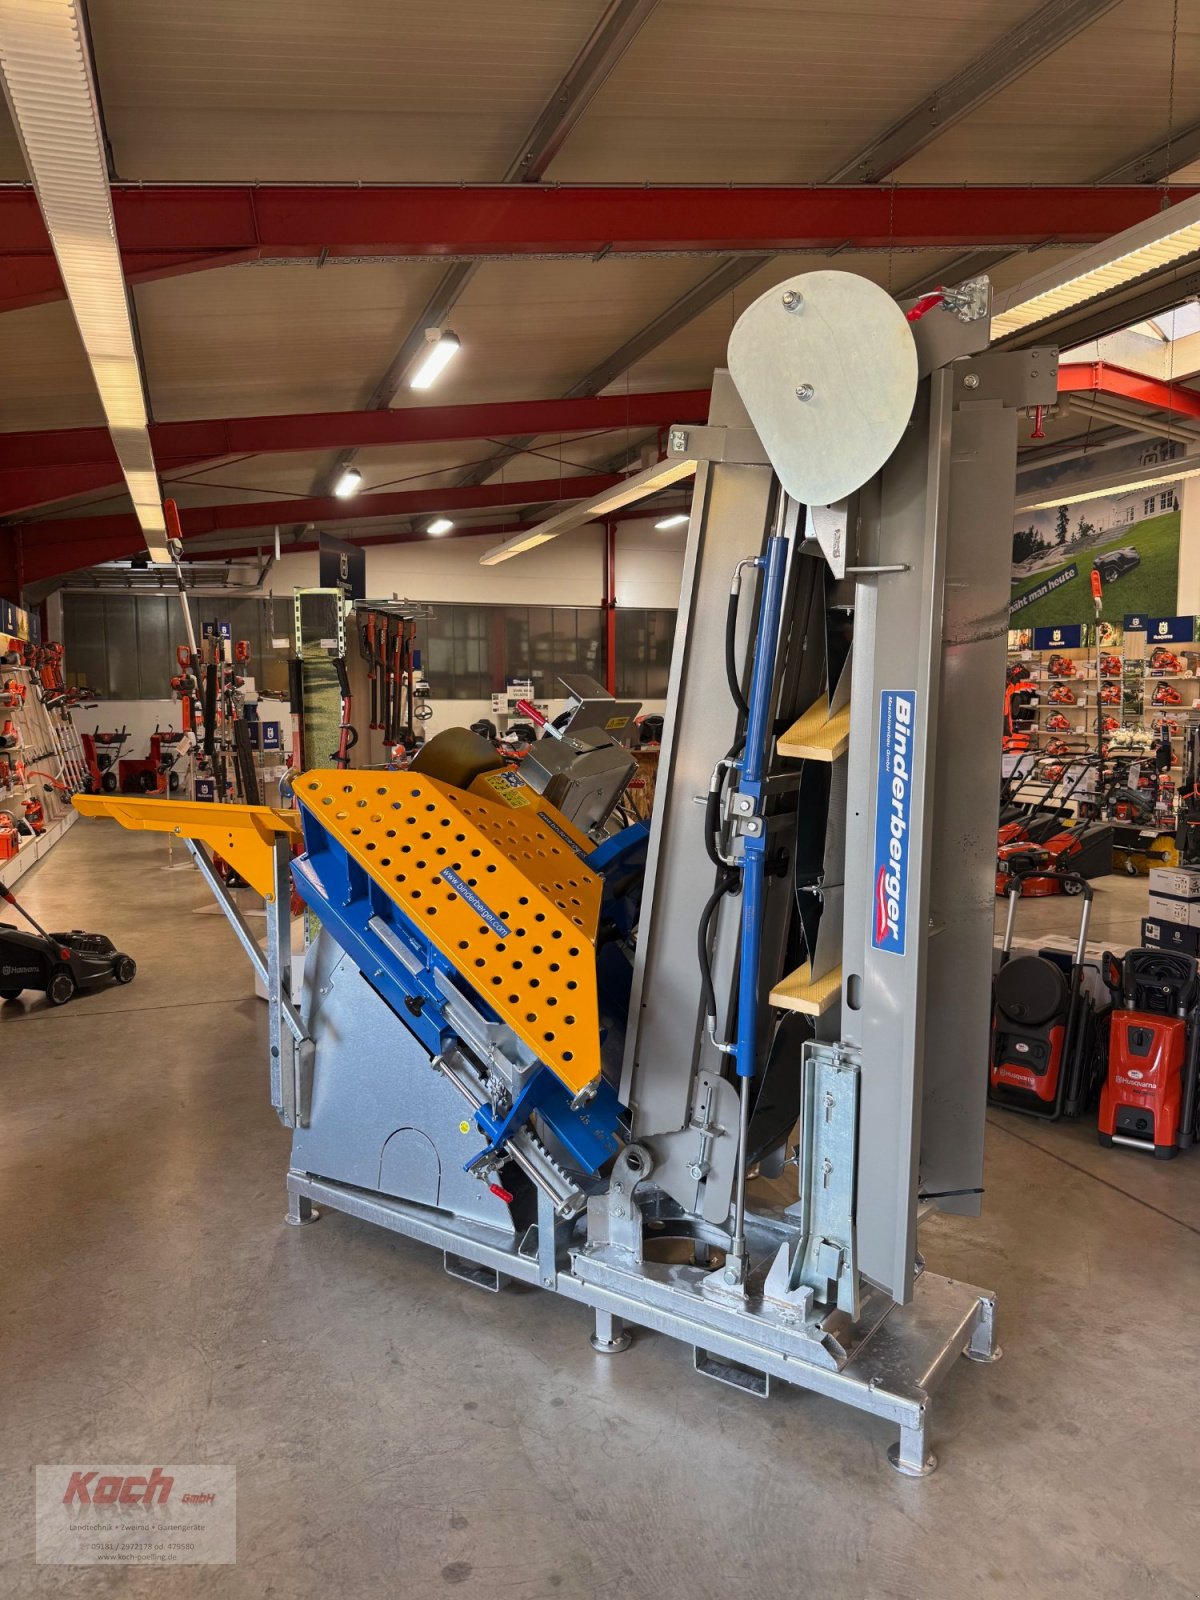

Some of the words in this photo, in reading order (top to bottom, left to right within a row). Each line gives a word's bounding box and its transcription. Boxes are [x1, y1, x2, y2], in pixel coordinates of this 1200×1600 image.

[1028, 585, 1048, 603] man
[1048, 569, 1075, 591] heute
[884, 695, 911, 941] Binderberger
[443, 868, 508, 937] www.binderberger.com
[1122, 1077, 1157, 1089] Husqvarna
